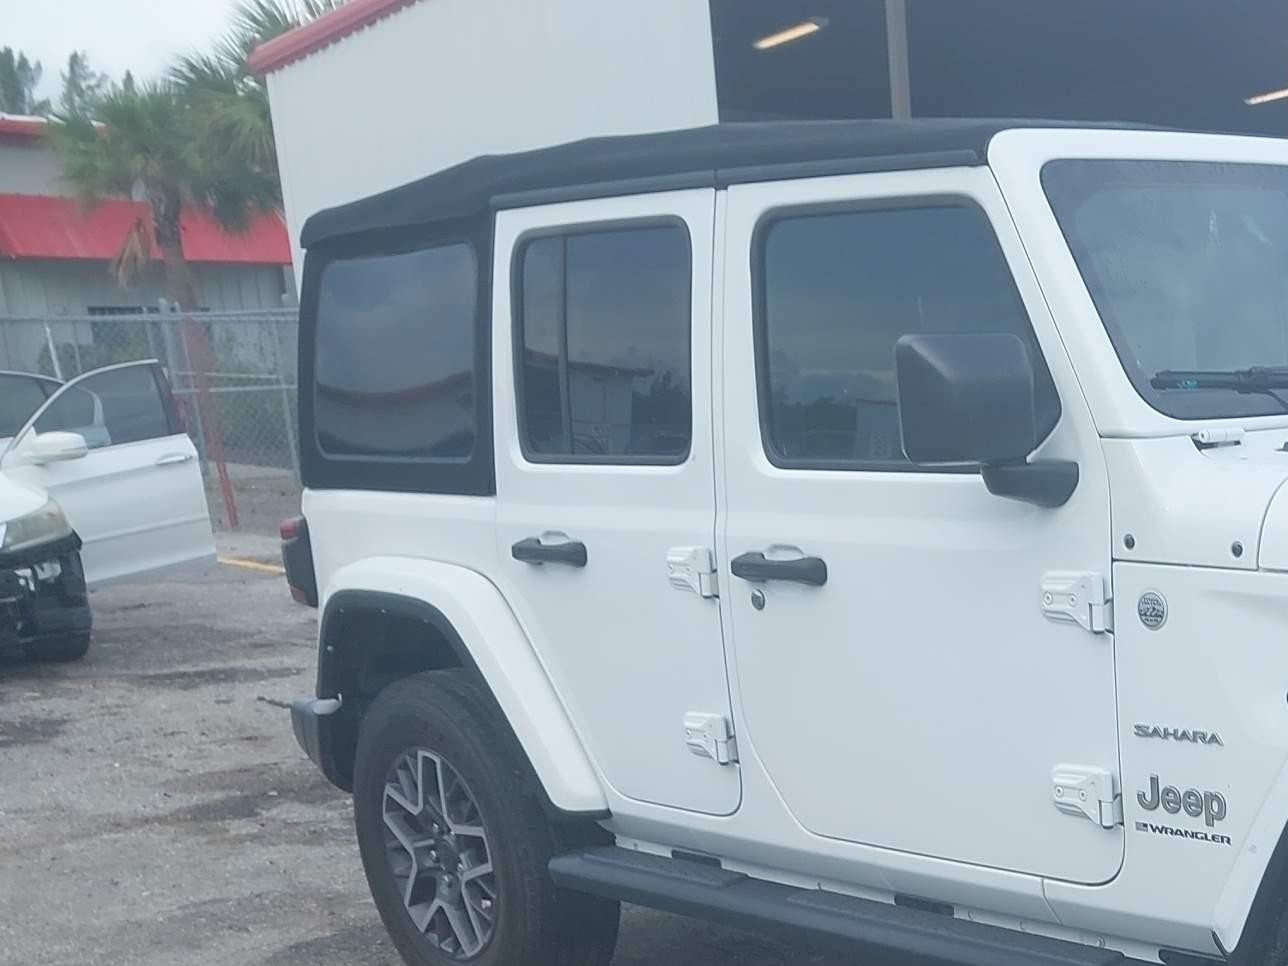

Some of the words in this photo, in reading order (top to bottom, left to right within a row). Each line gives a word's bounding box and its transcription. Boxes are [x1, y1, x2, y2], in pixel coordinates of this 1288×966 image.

[1133, 724, 1224, 746] SAHARA
[1136, 773, 1227, 827] Jeep
[1149, 823, 1232, 845] WRANGLER
